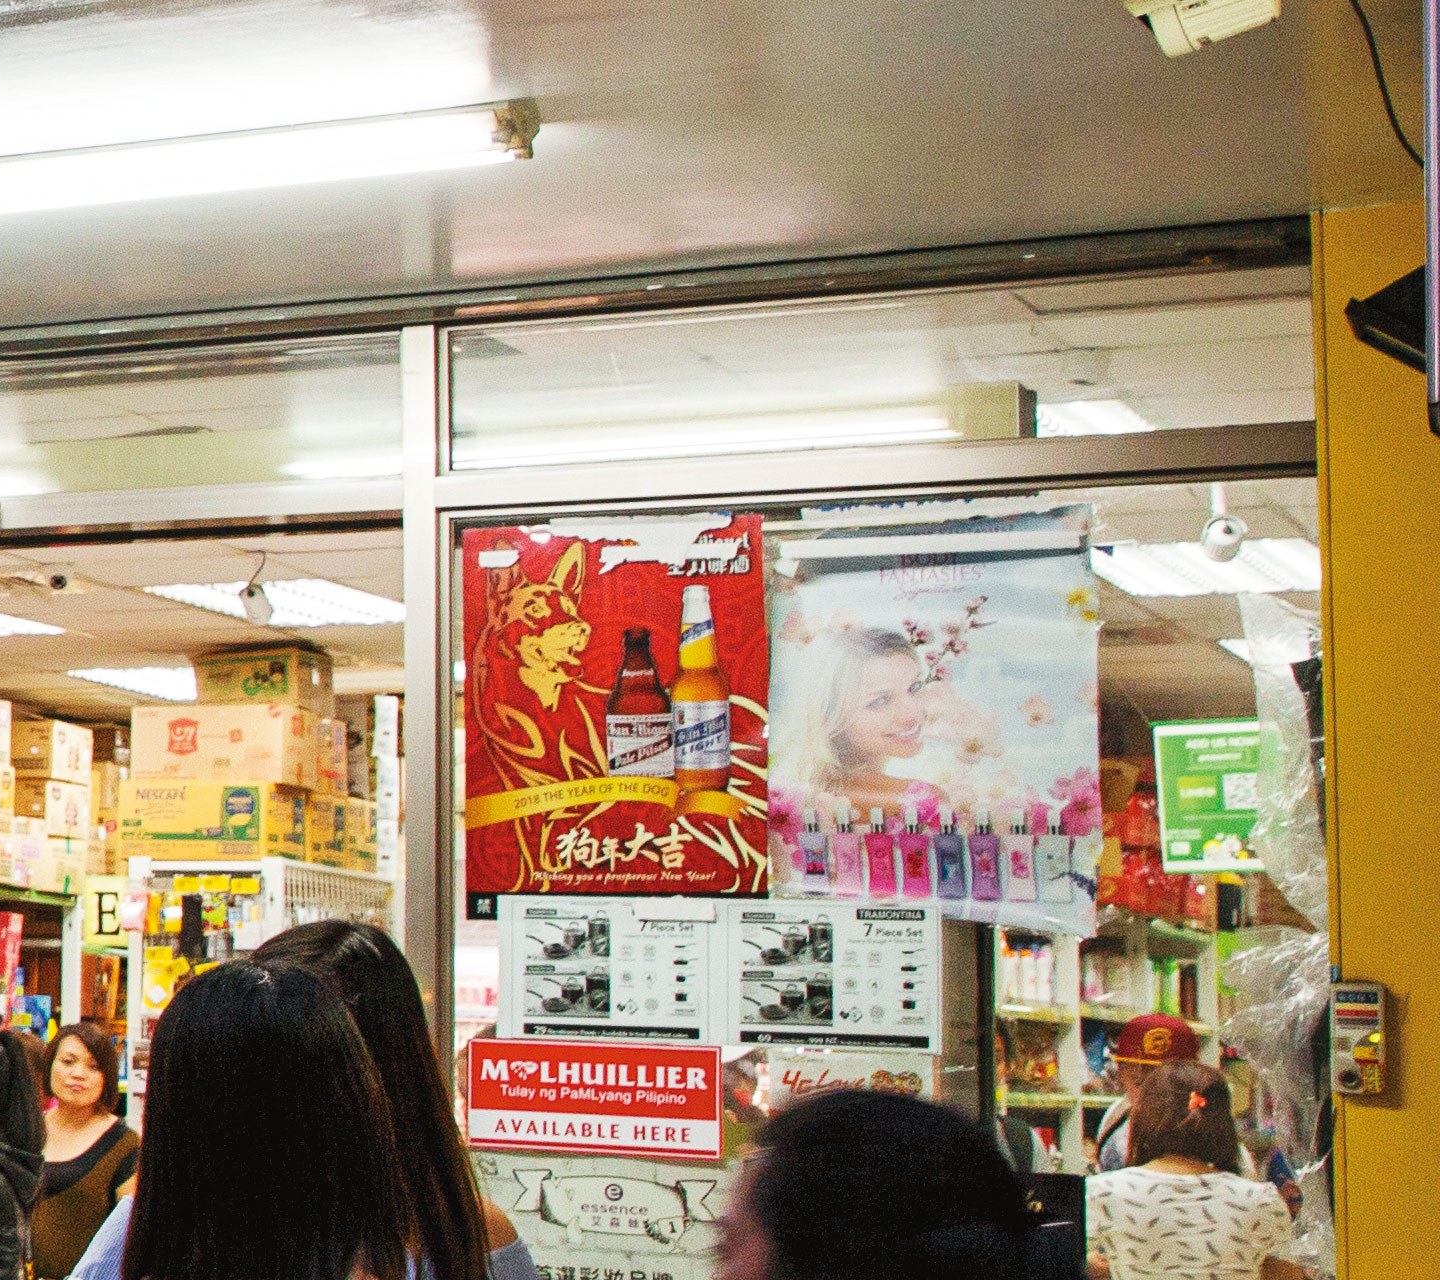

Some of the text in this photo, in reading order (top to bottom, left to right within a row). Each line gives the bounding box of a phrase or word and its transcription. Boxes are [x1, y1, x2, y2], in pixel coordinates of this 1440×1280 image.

[543, 782, 670, 802] THE YEAR OF THE DOG
[555, 822, 694, 870] 狗年大吉
[856, 909, 924, 921] TRAMONTINA
[499, 1083, 687, 1107] Tulay ng PaMLyang Pilipino
[493, 1118, 699, 1147] AVAILABLE HERE
[580, 1202, 650, 1216] essence
